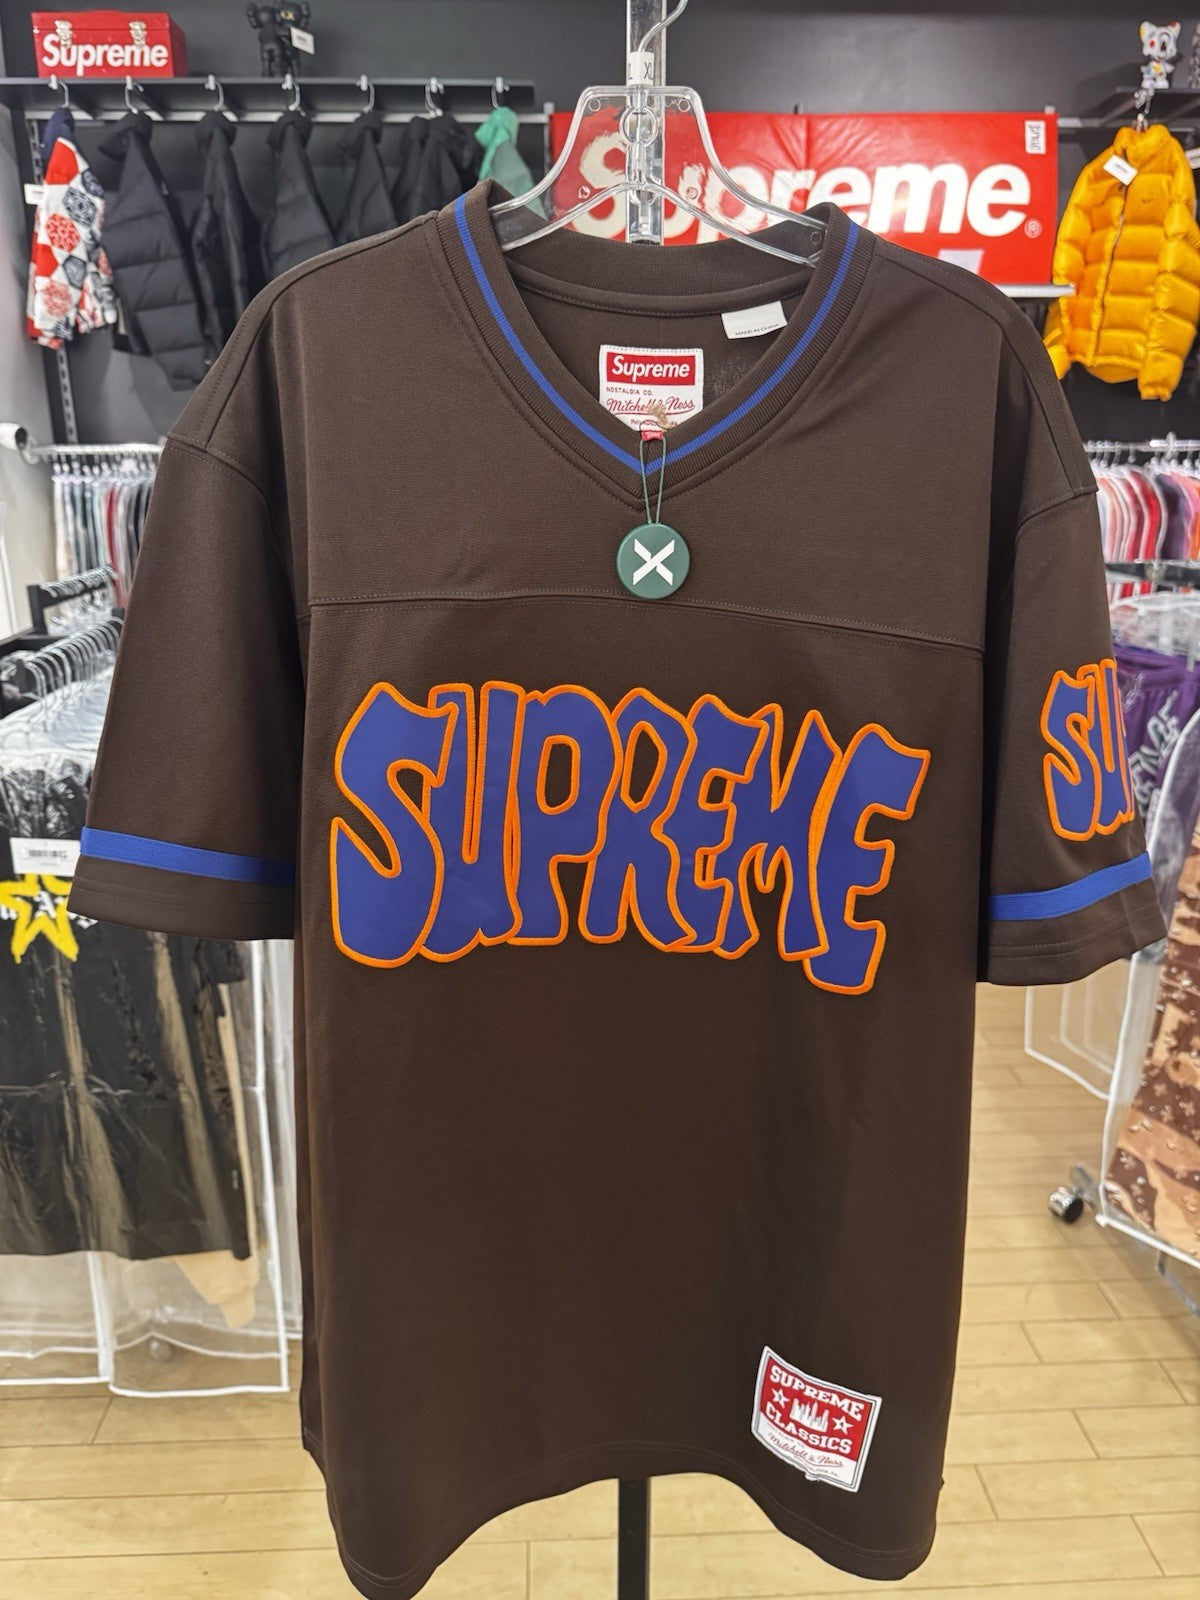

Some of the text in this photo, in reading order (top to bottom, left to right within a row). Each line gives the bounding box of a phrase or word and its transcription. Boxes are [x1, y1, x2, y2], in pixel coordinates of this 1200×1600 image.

[42, 33, 168, 77] Supreme
[606, 386, 640, 395] NOSTALGIA
[611, 354, 690, 383] Supreme
[665, 396, 695, 411] Ness
[329, 680, 930, 995] SUPREME
[769, 1364, 866, 1422] SUPREME
[765, 1400, 853, 1455] CLASSICS
